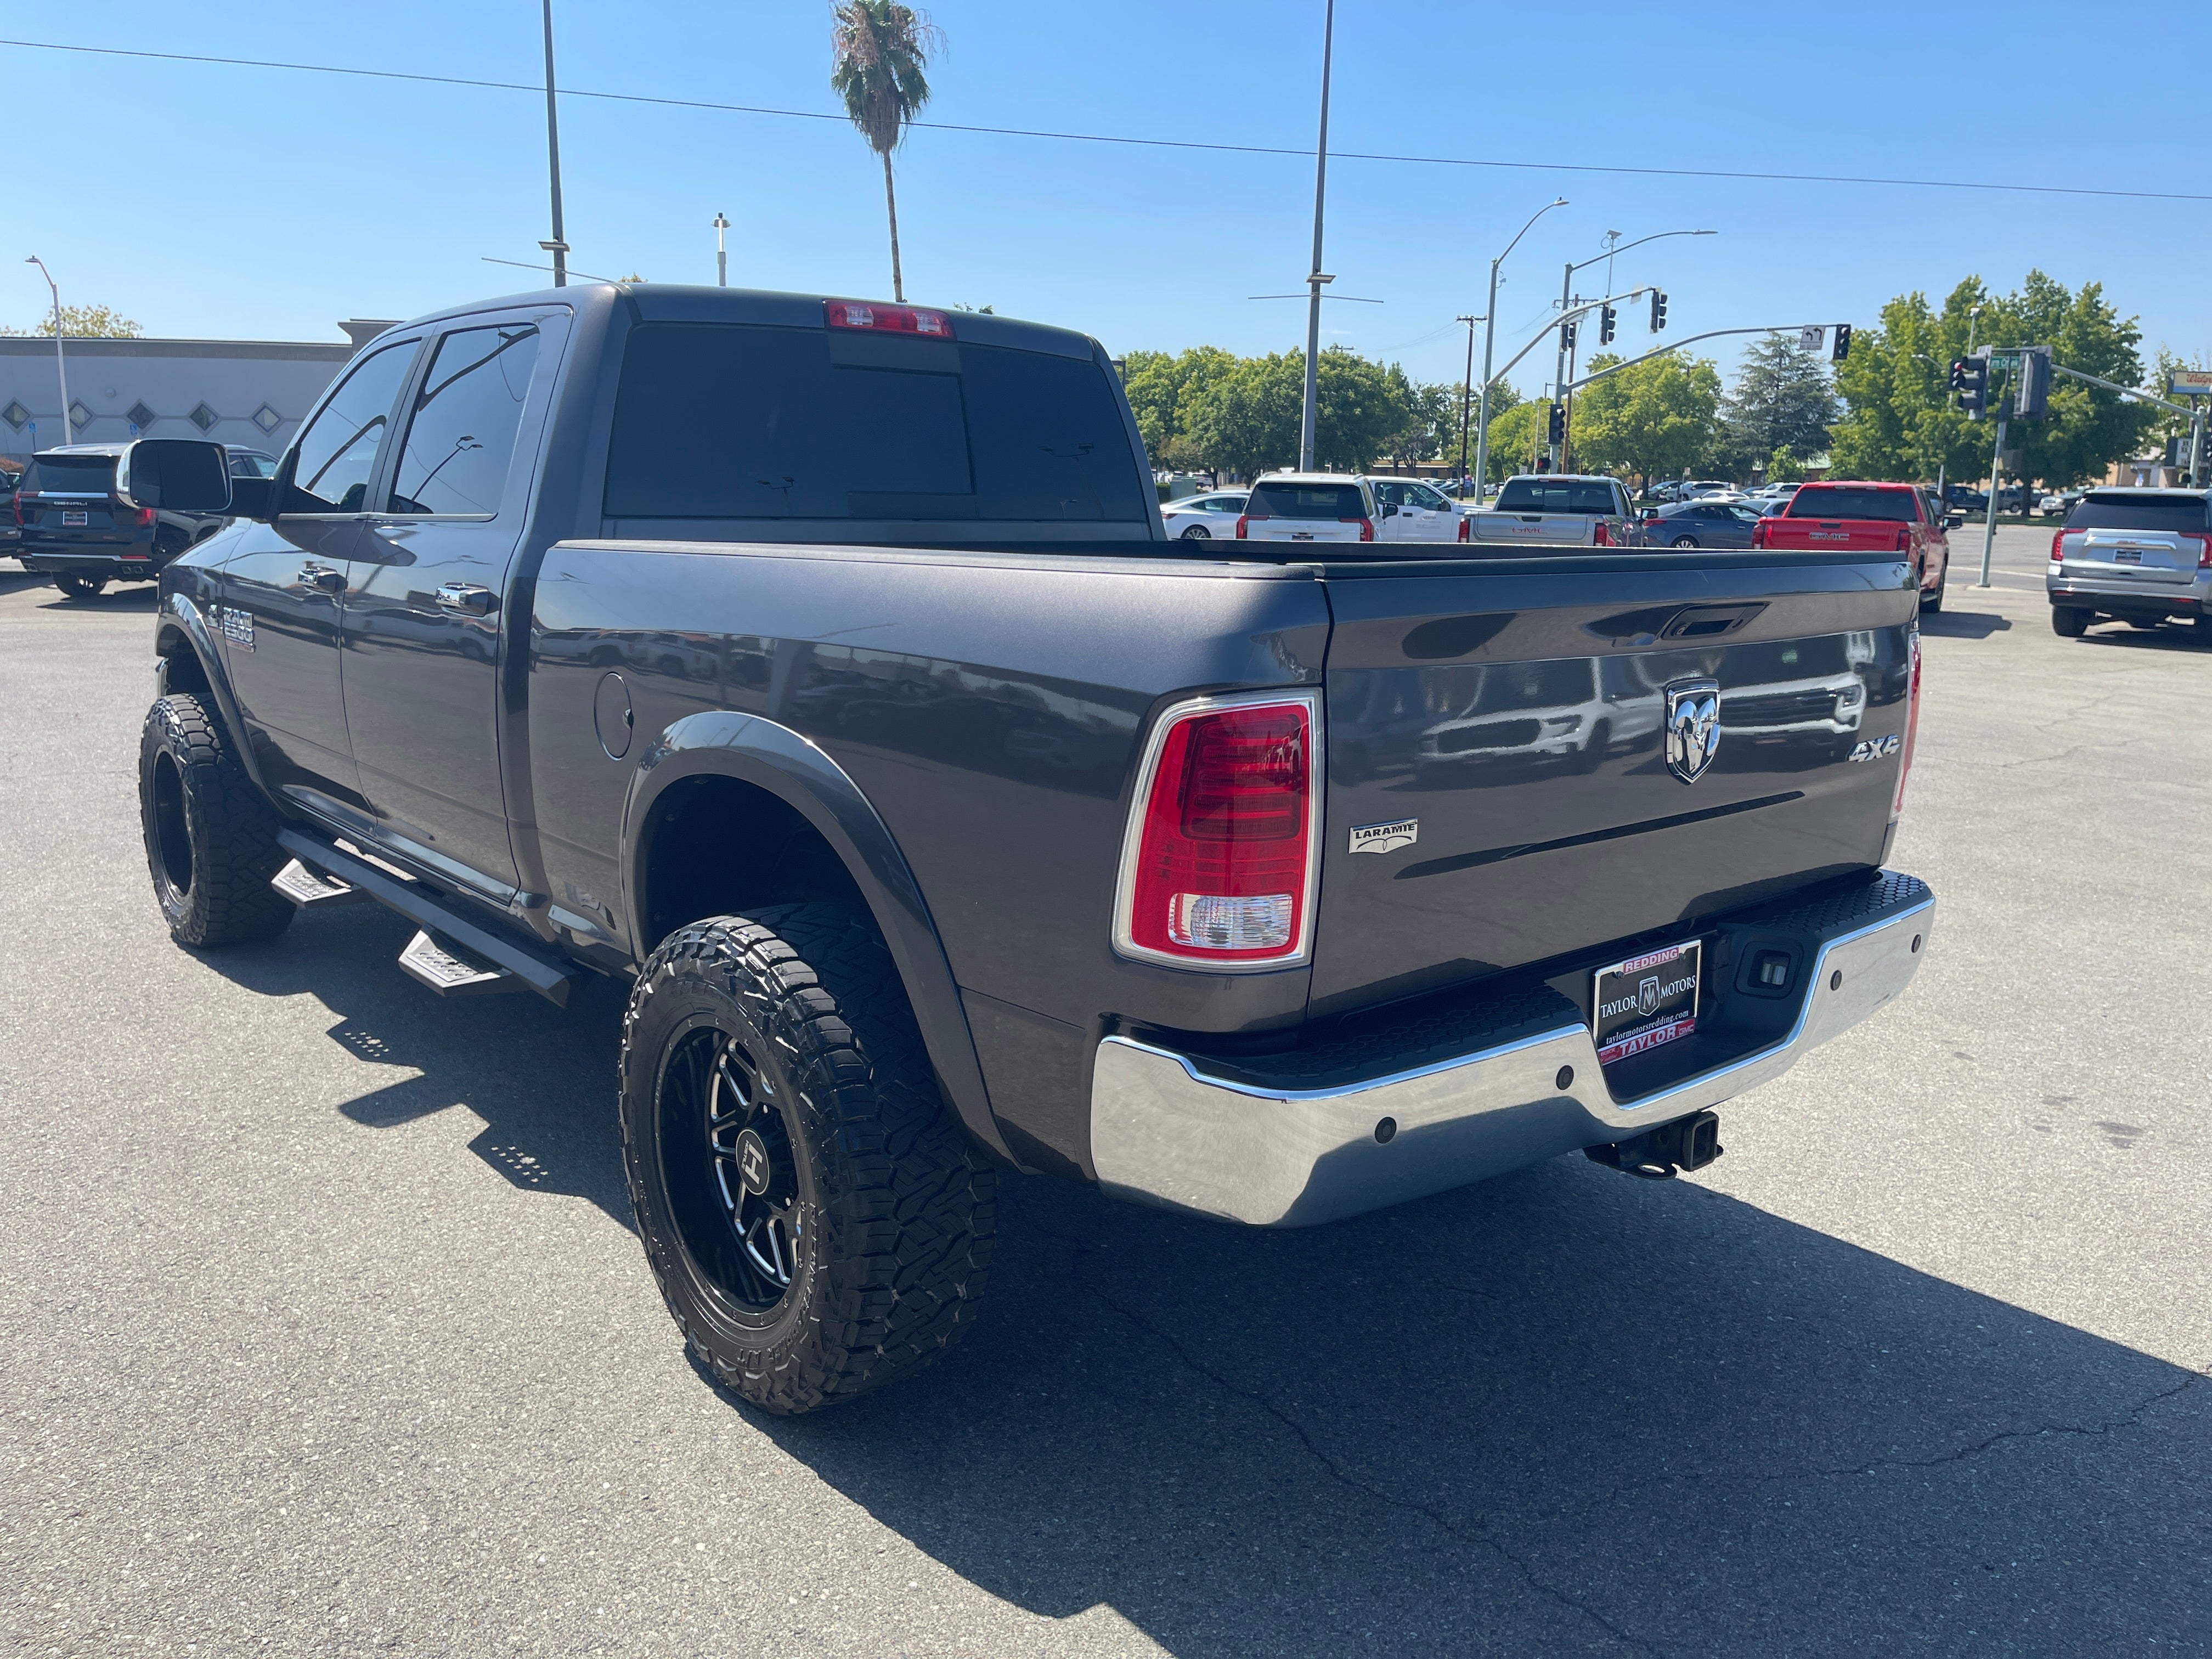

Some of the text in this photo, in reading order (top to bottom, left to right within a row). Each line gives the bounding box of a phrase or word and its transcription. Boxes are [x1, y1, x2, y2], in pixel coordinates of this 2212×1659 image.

[1809, 532, 1849, 541] GMC
[1355, 823, 1415, 839] LARAMIE
[1624, 949, 1679, 973] REDDING
[1600, 995, 1638, 1018] TAYLOR
[1661, 974, 1696, 999] MOTORS
[1606, 1009, 1689, 1045] taylormotorsredding.com
[1620, 1025, 1676, 1056] TAYLOR
[1679, 1024, 1694, 1036] GMC
